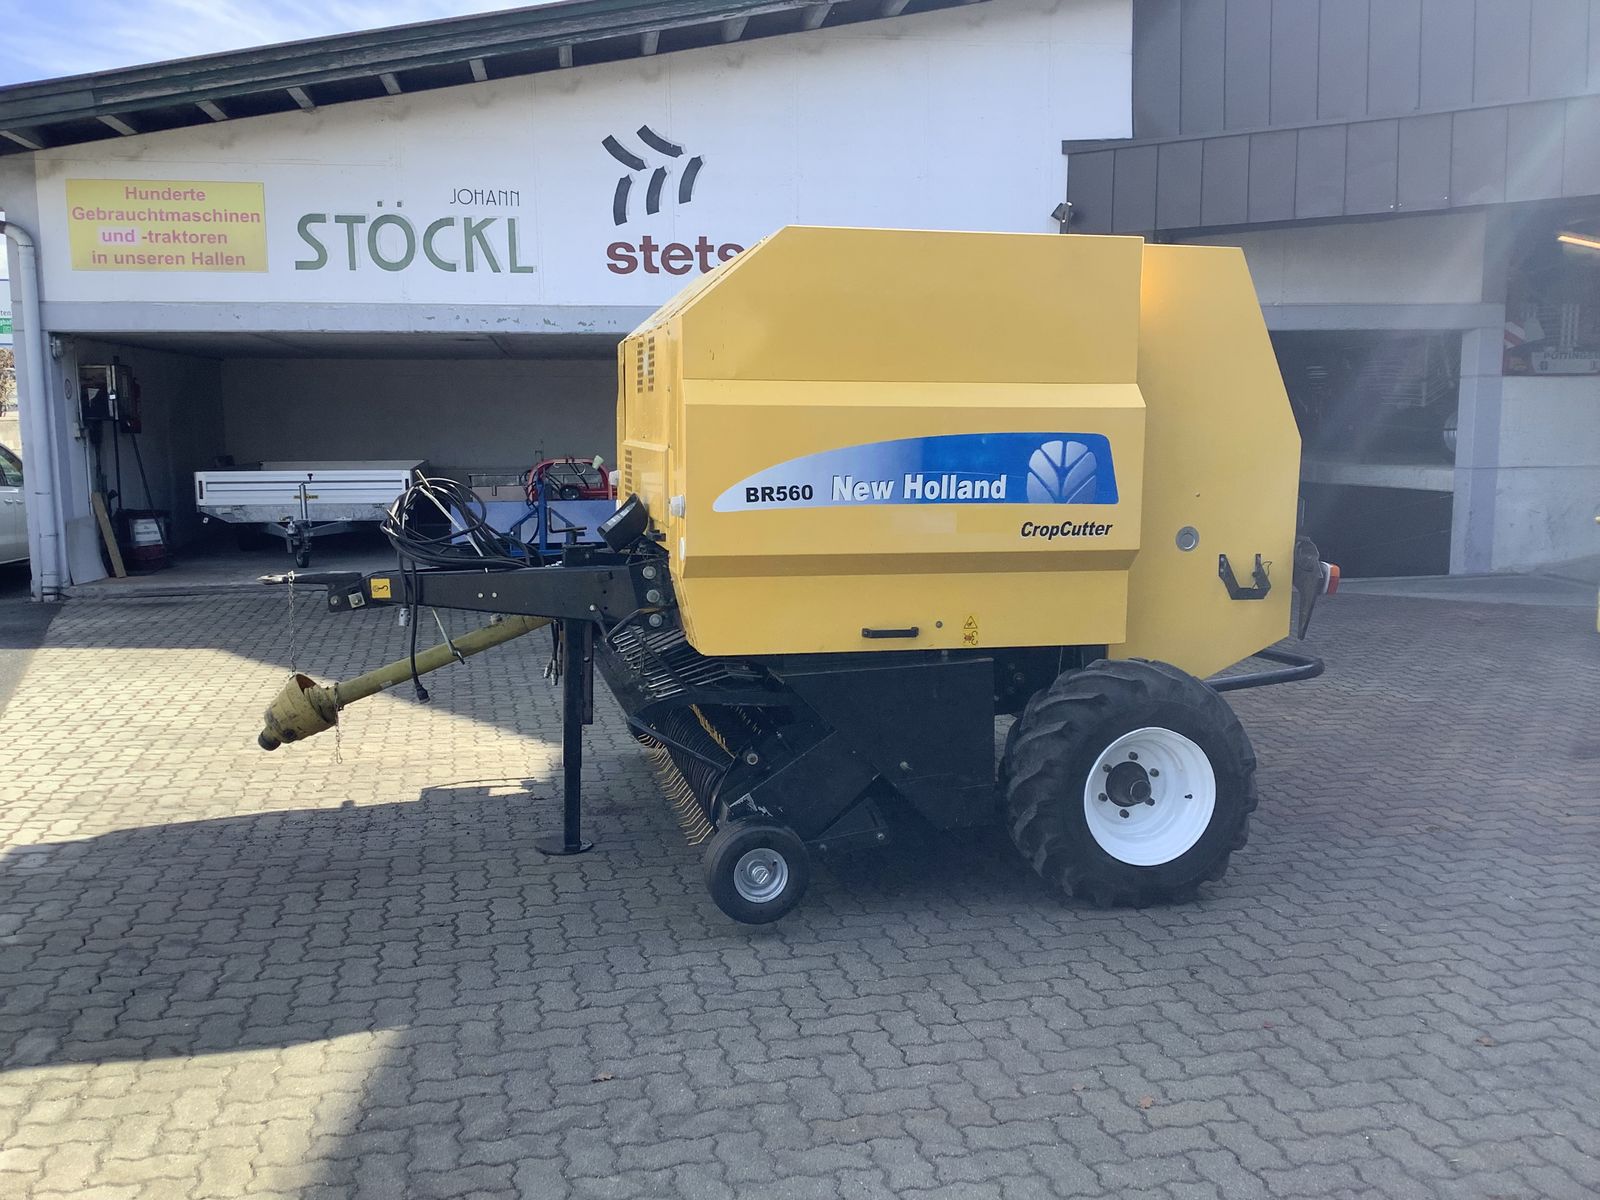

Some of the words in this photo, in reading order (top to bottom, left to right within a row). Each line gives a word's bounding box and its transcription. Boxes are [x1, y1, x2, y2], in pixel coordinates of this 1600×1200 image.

[125, 186, 206, 202] Hunderte
[450, 188, 521, 207] JOHANN
[72, 206, 261, 224] Gebrauchtmaschinen
[102, 229, 136, 243] und
[141, 229, 228, 244] -traktoren
[295, 200, 535, 274] STÖCKL
[92, 250, 108, 265] in
[114, 252, 186, 266] unseren
[191, 251, 246, 266] Hallen
[745, 484, 814, 503] BR560
[832, 474, 894, 501] New
[903, 473, 1008, 500] Holland
[1021, 521, 1113, 541] CropCutter
